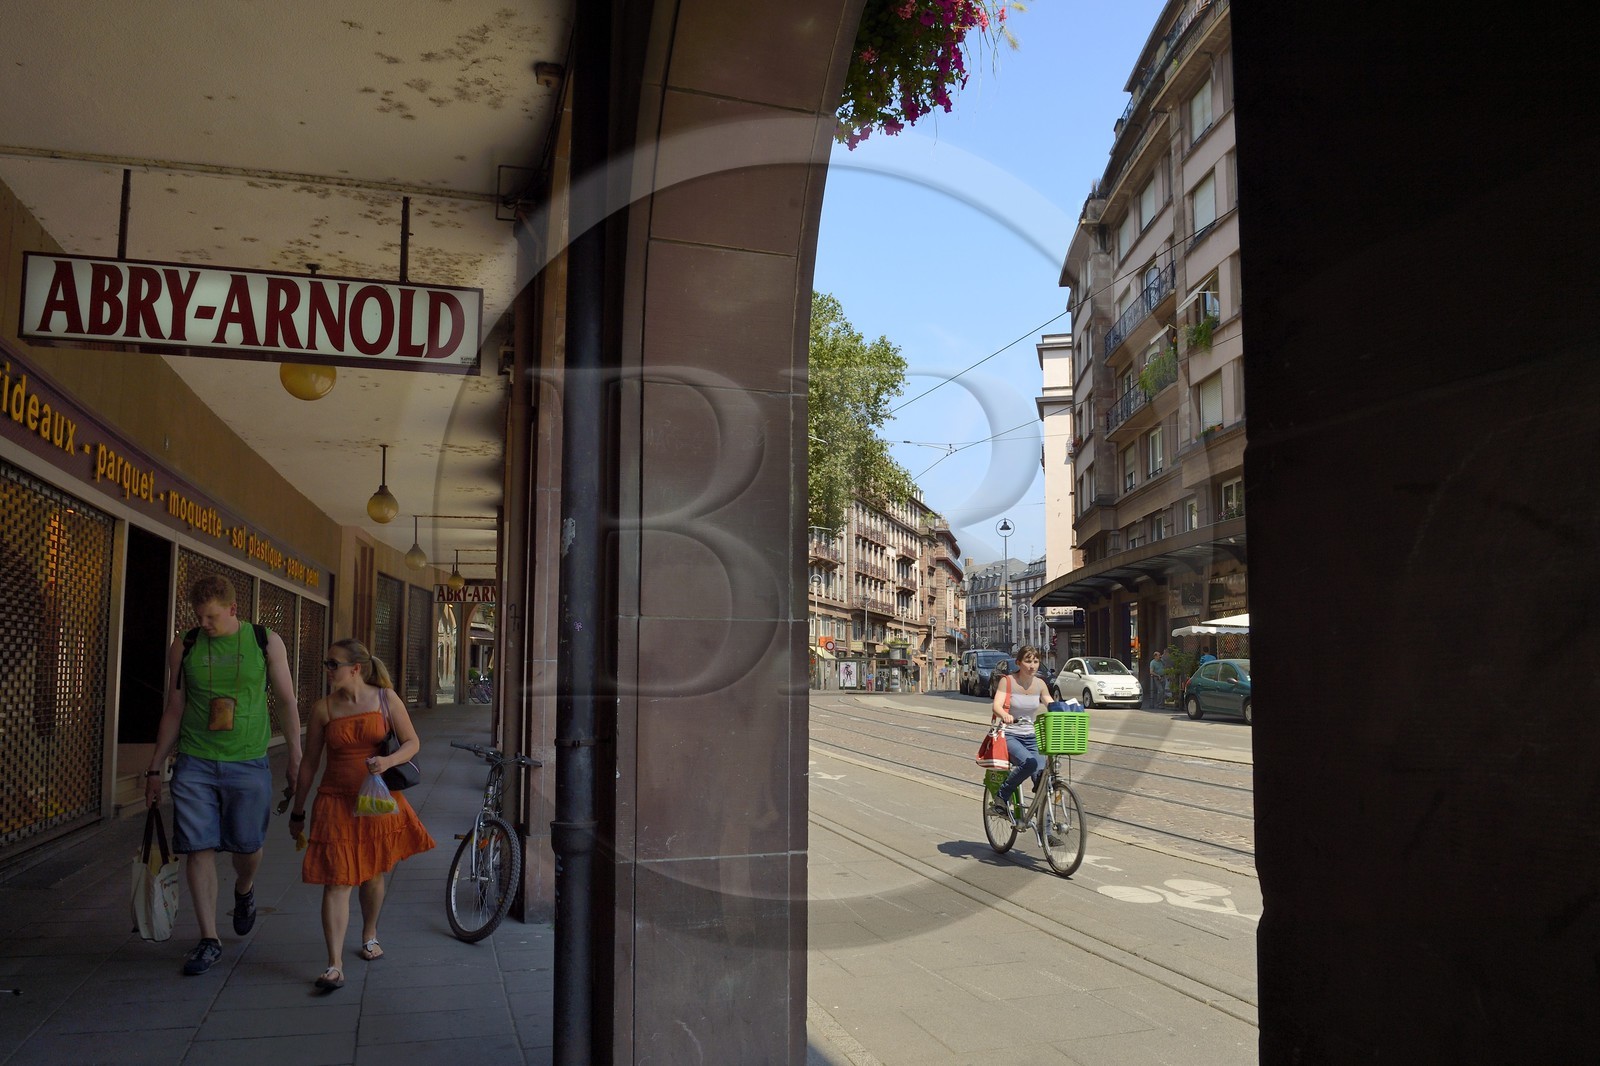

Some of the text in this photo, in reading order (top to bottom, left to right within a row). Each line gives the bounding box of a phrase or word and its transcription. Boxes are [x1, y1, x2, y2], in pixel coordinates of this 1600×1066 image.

[35, 259, 466, 359] ABRY-ARNOLD
[0, 361, 76, 456] ideaux
[96, 442, 155, 503] parquet
[169, 489, 222, 539] moquette
[232, 525, 247, 552] sol
[248, 532, 282, 571] plastique
